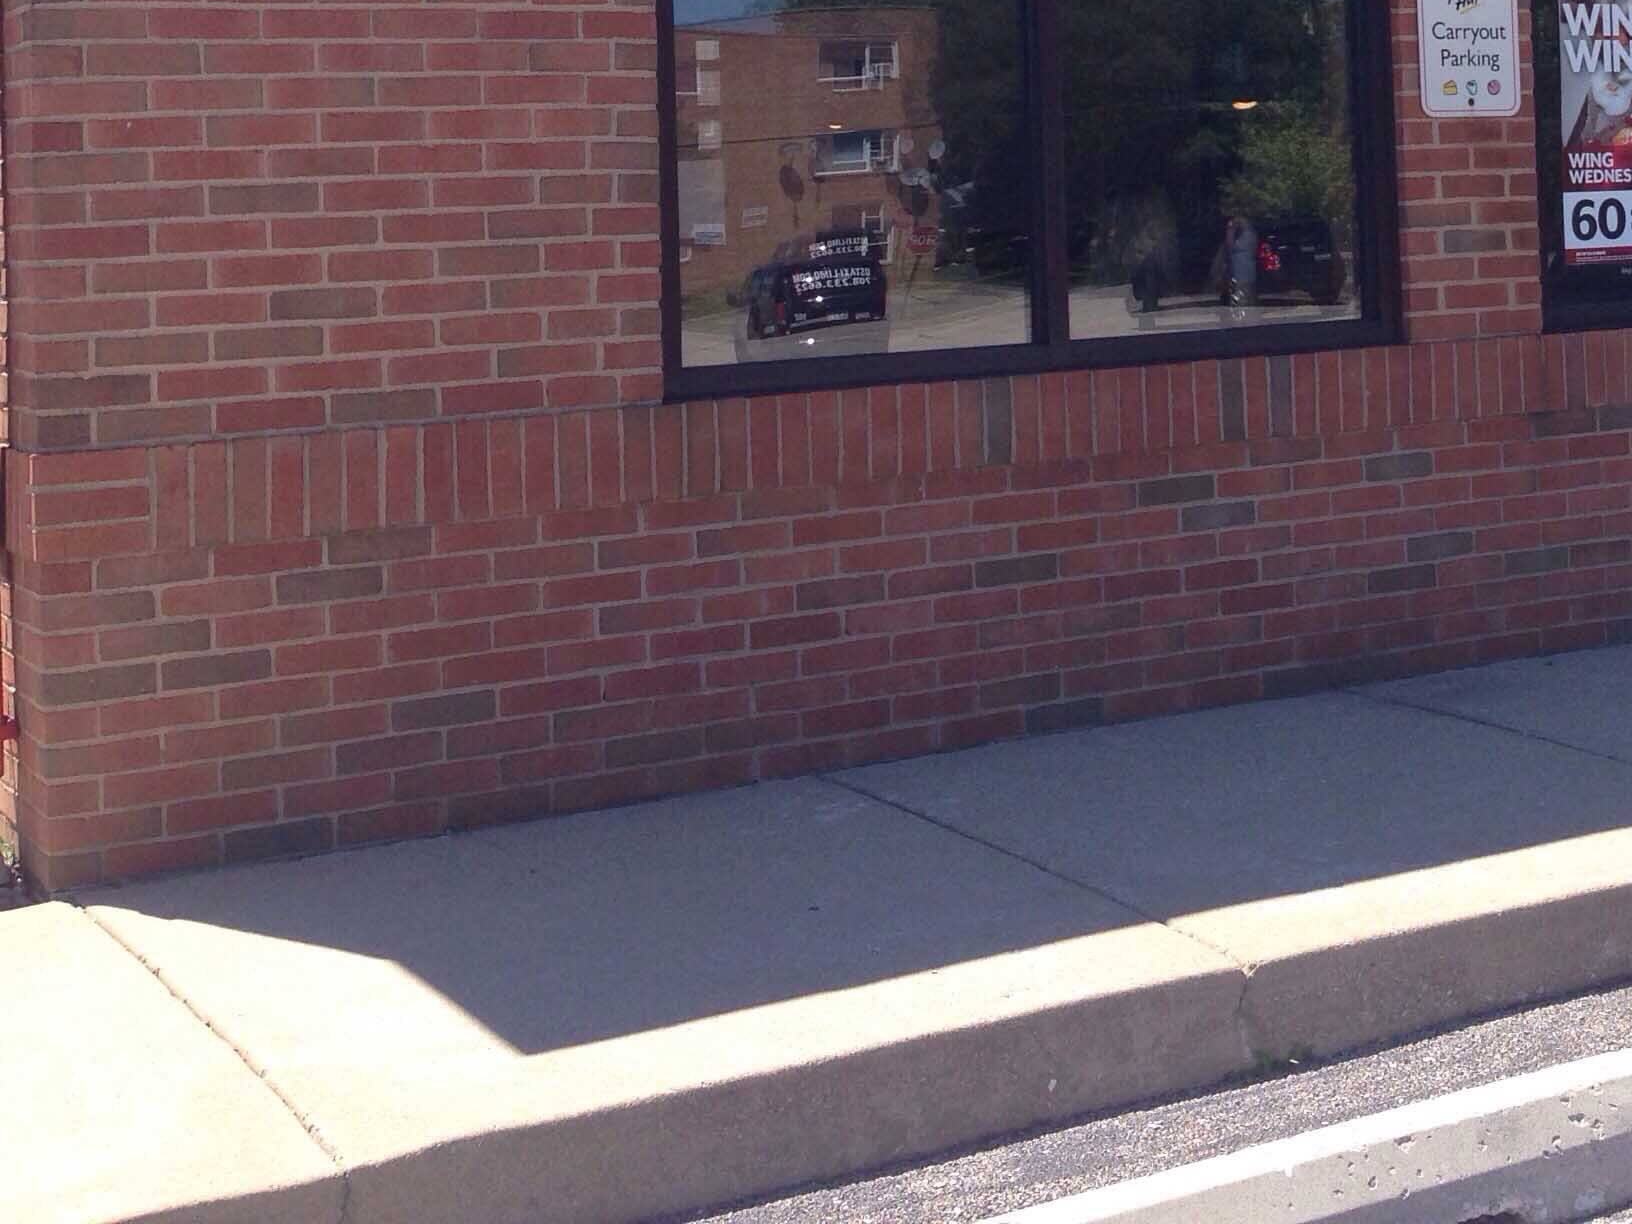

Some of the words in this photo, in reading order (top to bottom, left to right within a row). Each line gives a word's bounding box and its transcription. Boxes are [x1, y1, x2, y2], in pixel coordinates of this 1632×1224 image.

[1431, 21, 1507, 45] Carryout
[1440, 48, 1501, 72] Parking
[1568, 152, 1614, 169] WING
[1571, 198, 1626, 241] 60
